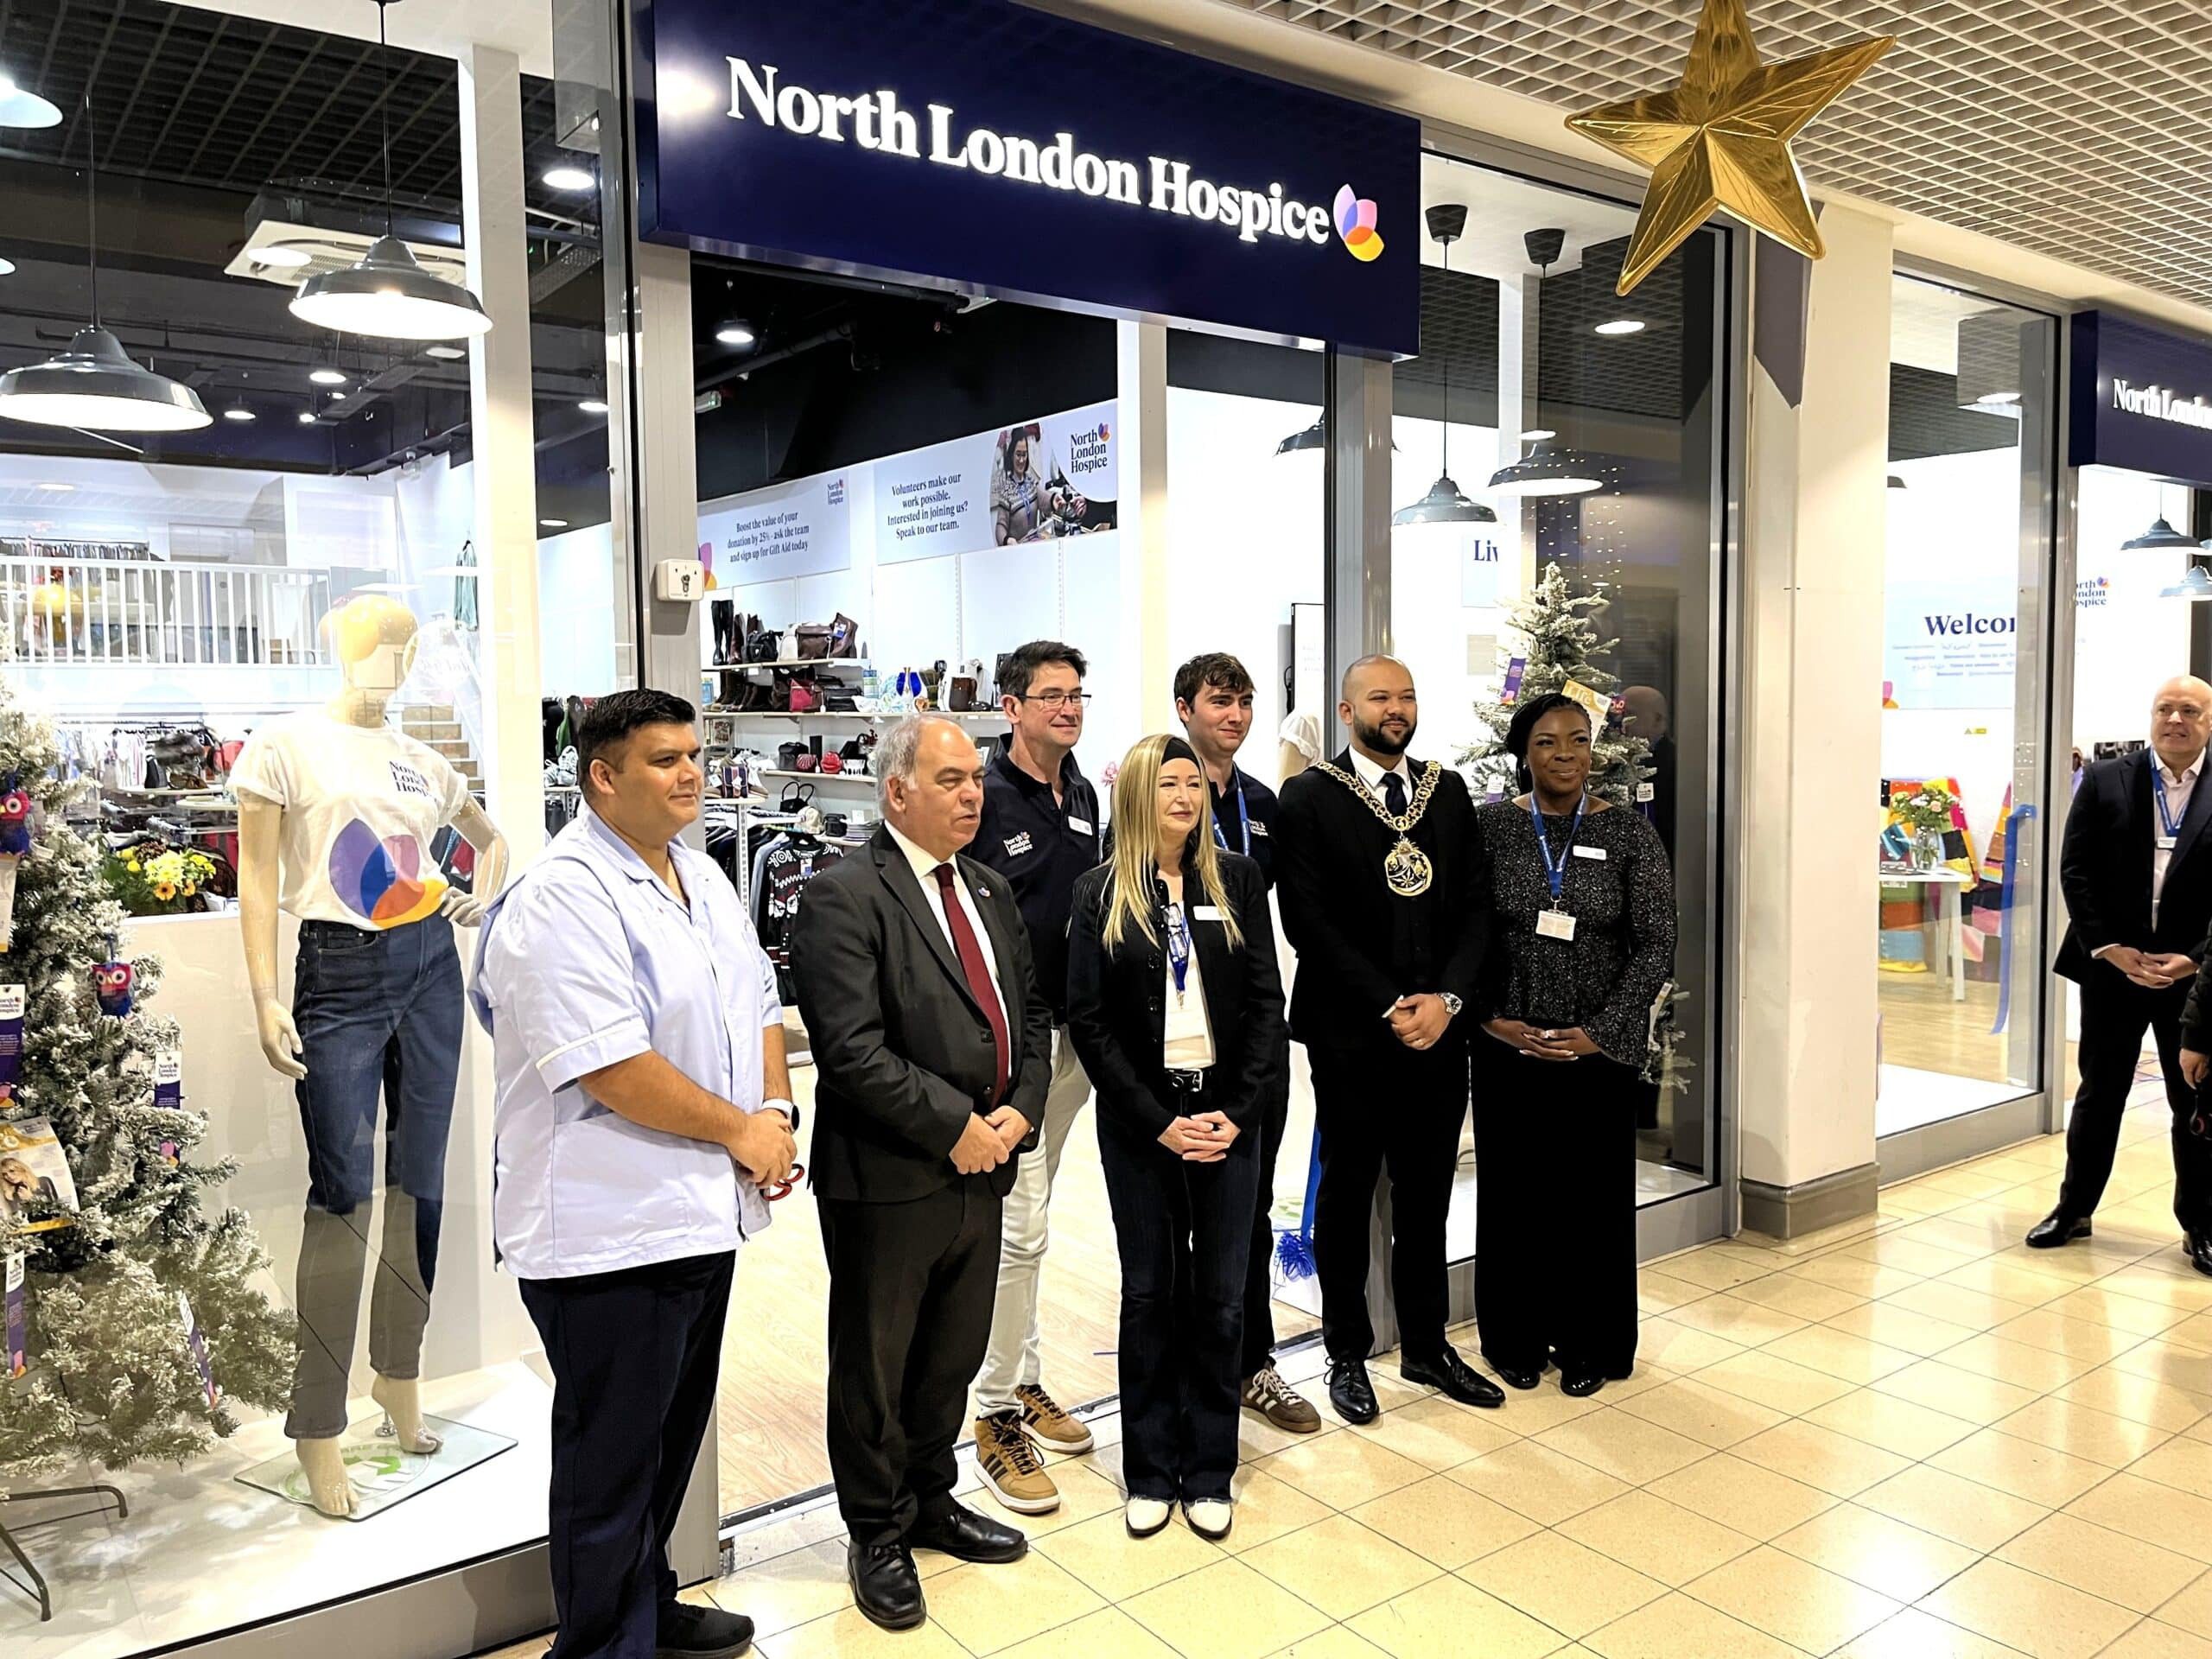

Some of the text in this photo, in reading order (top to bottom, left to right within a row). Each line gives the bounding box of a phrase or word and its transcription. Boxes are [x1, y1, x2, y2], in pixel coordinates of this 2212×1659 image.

[725, 55, 1331, 245] North London Hospice
[2113, 378, 2161, 418] North
[1071, 429, 1098, 447] North
[1071, 443, 1107, 461] London
[1071, 455, 1108, 474] Hospice
[892, 474, 962, 496] Volunteers make our
[902, 489, 951, 508] work possible.
[736, 512, 798, 533] Boost the value of your
[887, 500, 969, 525] Interested in joining us?
[728, 535, 751, 549] donation
[751, 533, 759, 546] by
[773, 528, 784, 539] ask
[785, 526, 794, 537] the
[794, 525, 810, 536] team
[896, 520, 960, 540] Speak to our team.
[730, 538, 809, 563] and sign up for Gift Aid today
